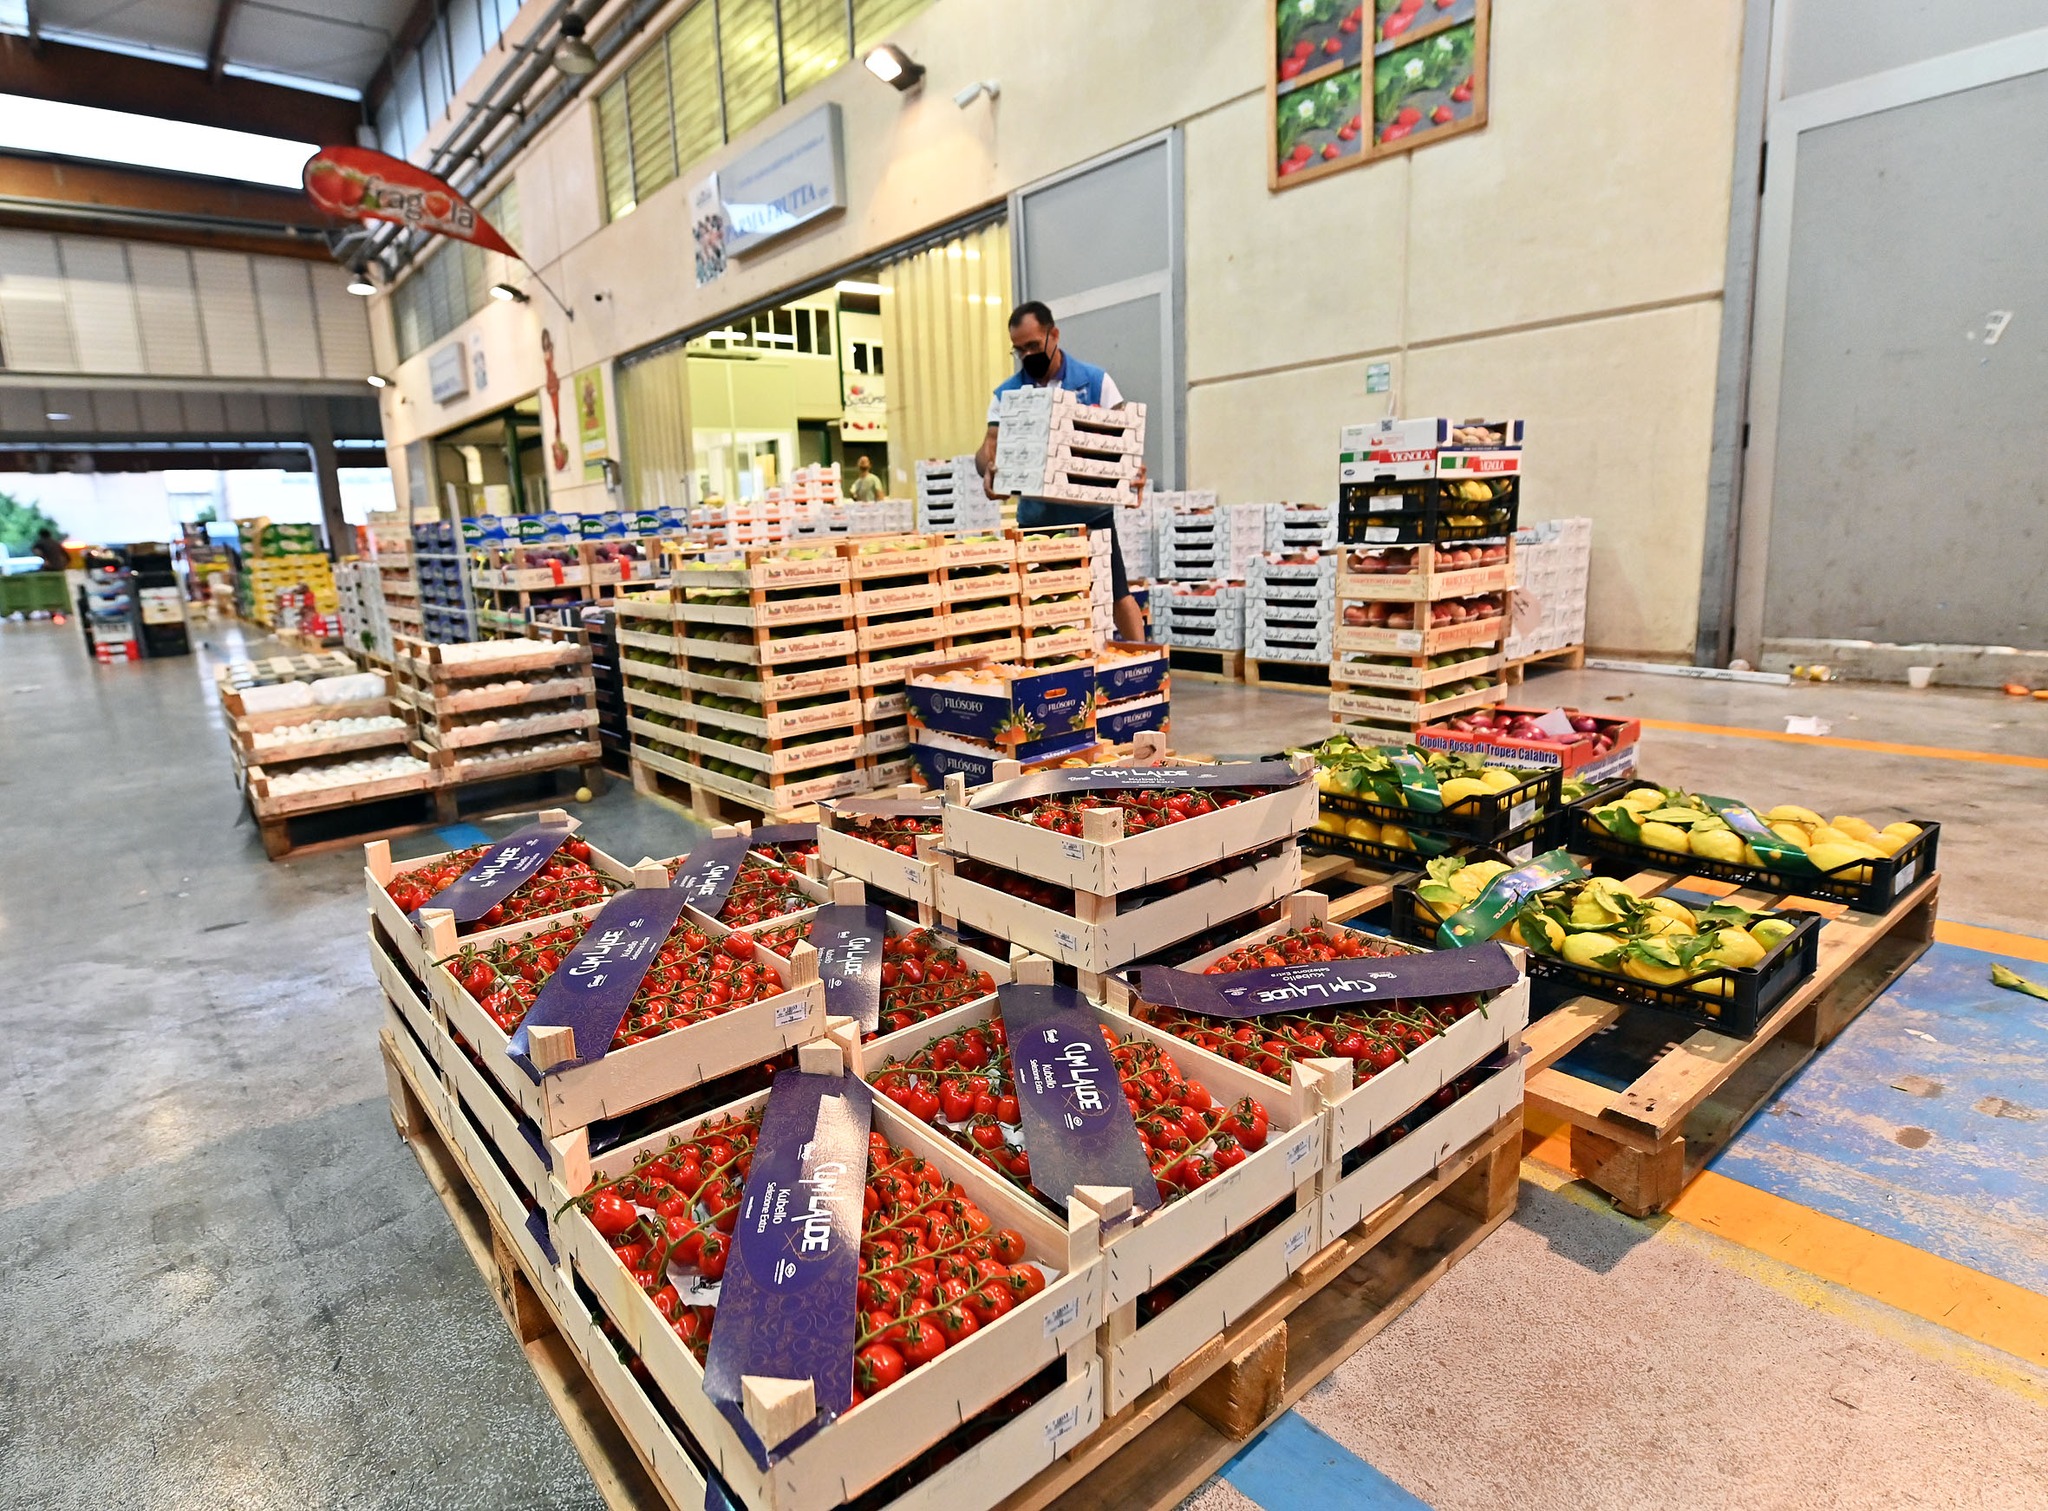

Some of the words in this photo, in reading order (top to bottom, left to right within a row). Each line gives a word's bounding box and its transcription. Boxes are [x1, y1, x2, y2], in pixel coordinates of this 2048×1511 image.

[462, 526, 482, 538] rutta
[1125, 666, 1153, 679] FILÓSOFO
[944, 695, 982, 712] FILÓSOFO
[1048, 699, 1076, 712] FILÓSOFO
[1124, 711, 1152, 725] FILÓSOFO
[1420, 735, 1447, 750] Cipolla
[1449, 739, 1474, 753] Rossa
[1476, 742, 1484, 754] di
[1486, 743, 1516, 759] Tropea
[1518, 748, 1558, 764] Calabria
[947, 756, 986, 774] FILÓSOFO
[1090, 769, 1128, 779] CUM
[1132, 769, 1190, 779] LAUDE
[483, 846, 521, 869] LAUDE
[469, 868, 505, 882] CUM
[702, 865, 730, 878] CUM
[695, 877, 725, 895] LAUDE
[582, 930, 626, 956] LAUDE
[838, 937, 872, 951] CUM
[568, 955, 613, 976] CUM
[835, 950, 870, 976] LAUDE
[1282, 972, 1326, 982] Kubello
[1328, 976, 1378, 994] CUM
[1256, 982, 1330, 1003] LAUDE
[1054, 1042, 1092, 1067] CUM
[1041, 1063, 1057, 1089] Kubello
[1061, 1068, 1103, 1110] LAUDE
[798, 1161, 848, 1193] CUM
[772, 1188, 792, 1225] Kubello
[790, 1196, 845, 1253] LAUDE
